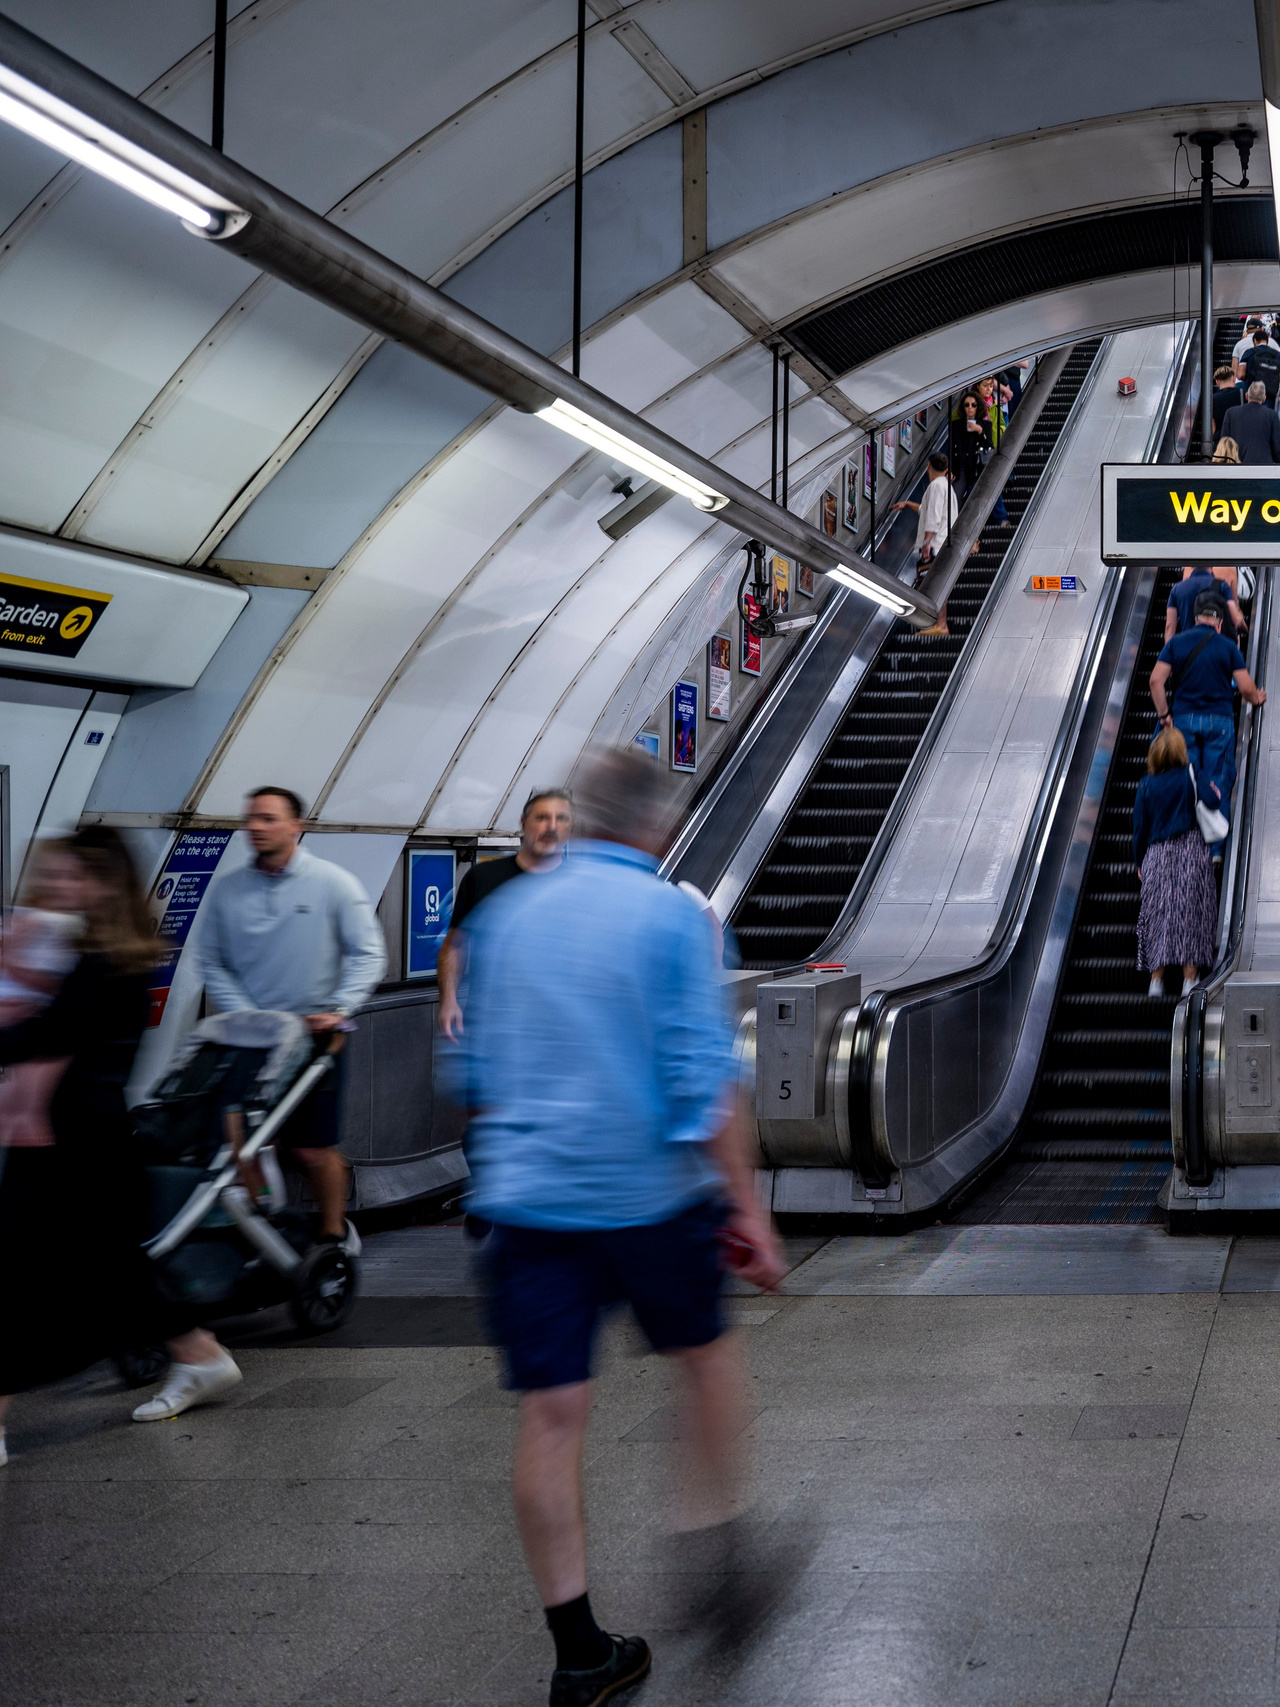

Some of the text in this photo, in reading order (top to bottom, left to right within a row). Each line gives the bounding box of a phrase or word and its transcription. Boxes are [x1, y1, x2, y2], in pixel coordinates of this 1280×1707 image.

[1169, 491, 1253, 532] Way
[1, 629, 46, 645] from exit
[180, 834, 230, 844] Please stand
[174, 846, 221, 858] on the right
[425, 914, 439, 926] global
[778, 1080, 792, 1100] 5
